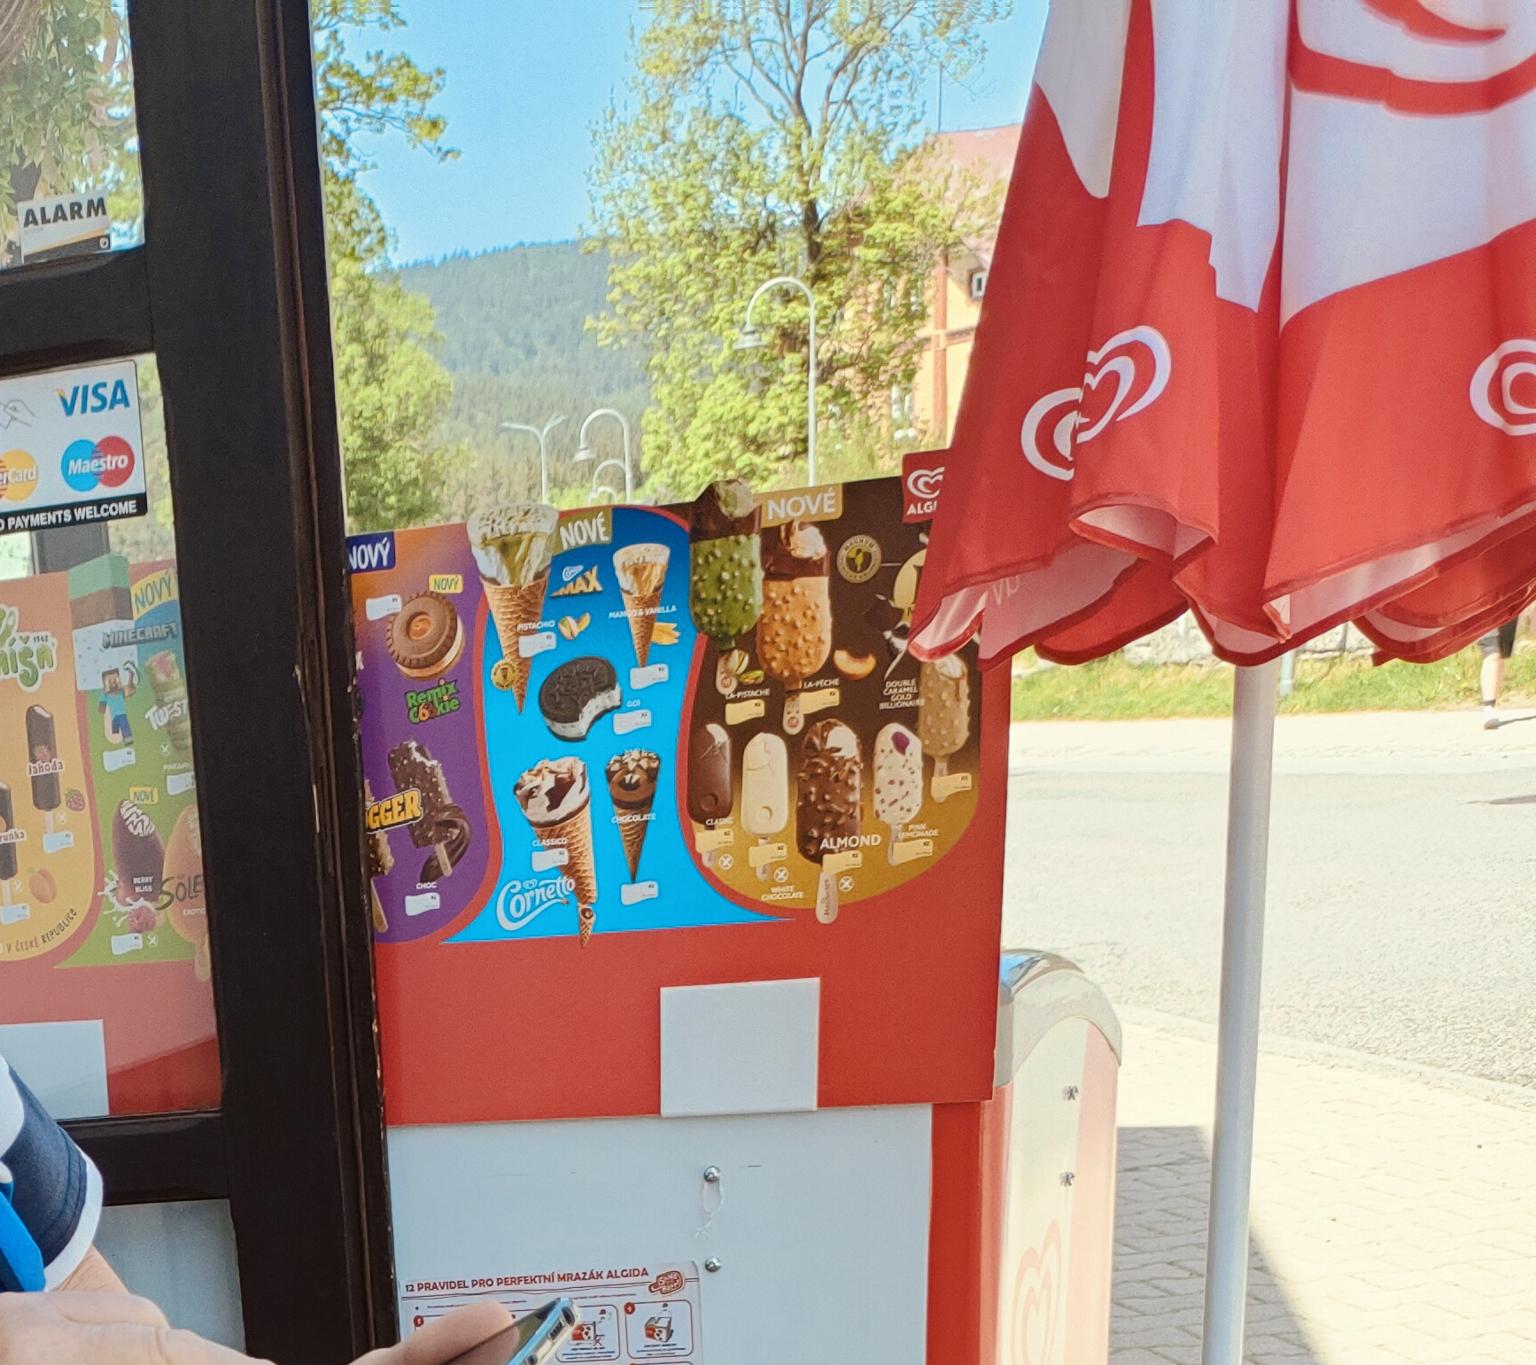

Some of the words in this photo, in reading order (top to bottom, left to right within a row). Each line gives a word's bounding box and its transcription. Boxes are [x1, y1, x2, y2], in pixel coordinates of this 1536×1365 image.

[23, 197, 107, 228] ALARM
[56, 379, 131, 417] VISA
[68, 455, 129, 476] Maestro
[7, 509, 72, 531] PAYMENTS
[74, 500, 137, 521] WELCOME
[767, 491, 837, 520] NOVÉ
[559, 511, 609, 548] NOVÉ
[348, 537, 391, 570] NOVÝ
[433, 575, 460, 591] NOVÝ
[550, 565, 604, 597] MAX
[102, 622, 177, 648] MINECRAFT
[517, 620, 555, 631] PISTACHIO
[28, 761, 64, 776] Jahoda
[366, 789, 422, 829] GGER
[611, 813, 657, 824] CHOCOLATE
[531, 837, 568, 847] CLASSICO
[820, 834, 882, 850] ALMOND
[415, 881, 438, 890] CHOC
[496, 875, 577, 931] Cornetto
[405, 1284, 415, 1292] 12
[417, 1280, 469, 1291] PRAVIDEL
[471, 1278, 494, 1288] PRO
[496, 1271, 555, 1286] PERFEKTNÍ
[557, 1269, 604, 1283] MRAZÁK
[606, 1267, 649, 1278] ALGIDA
